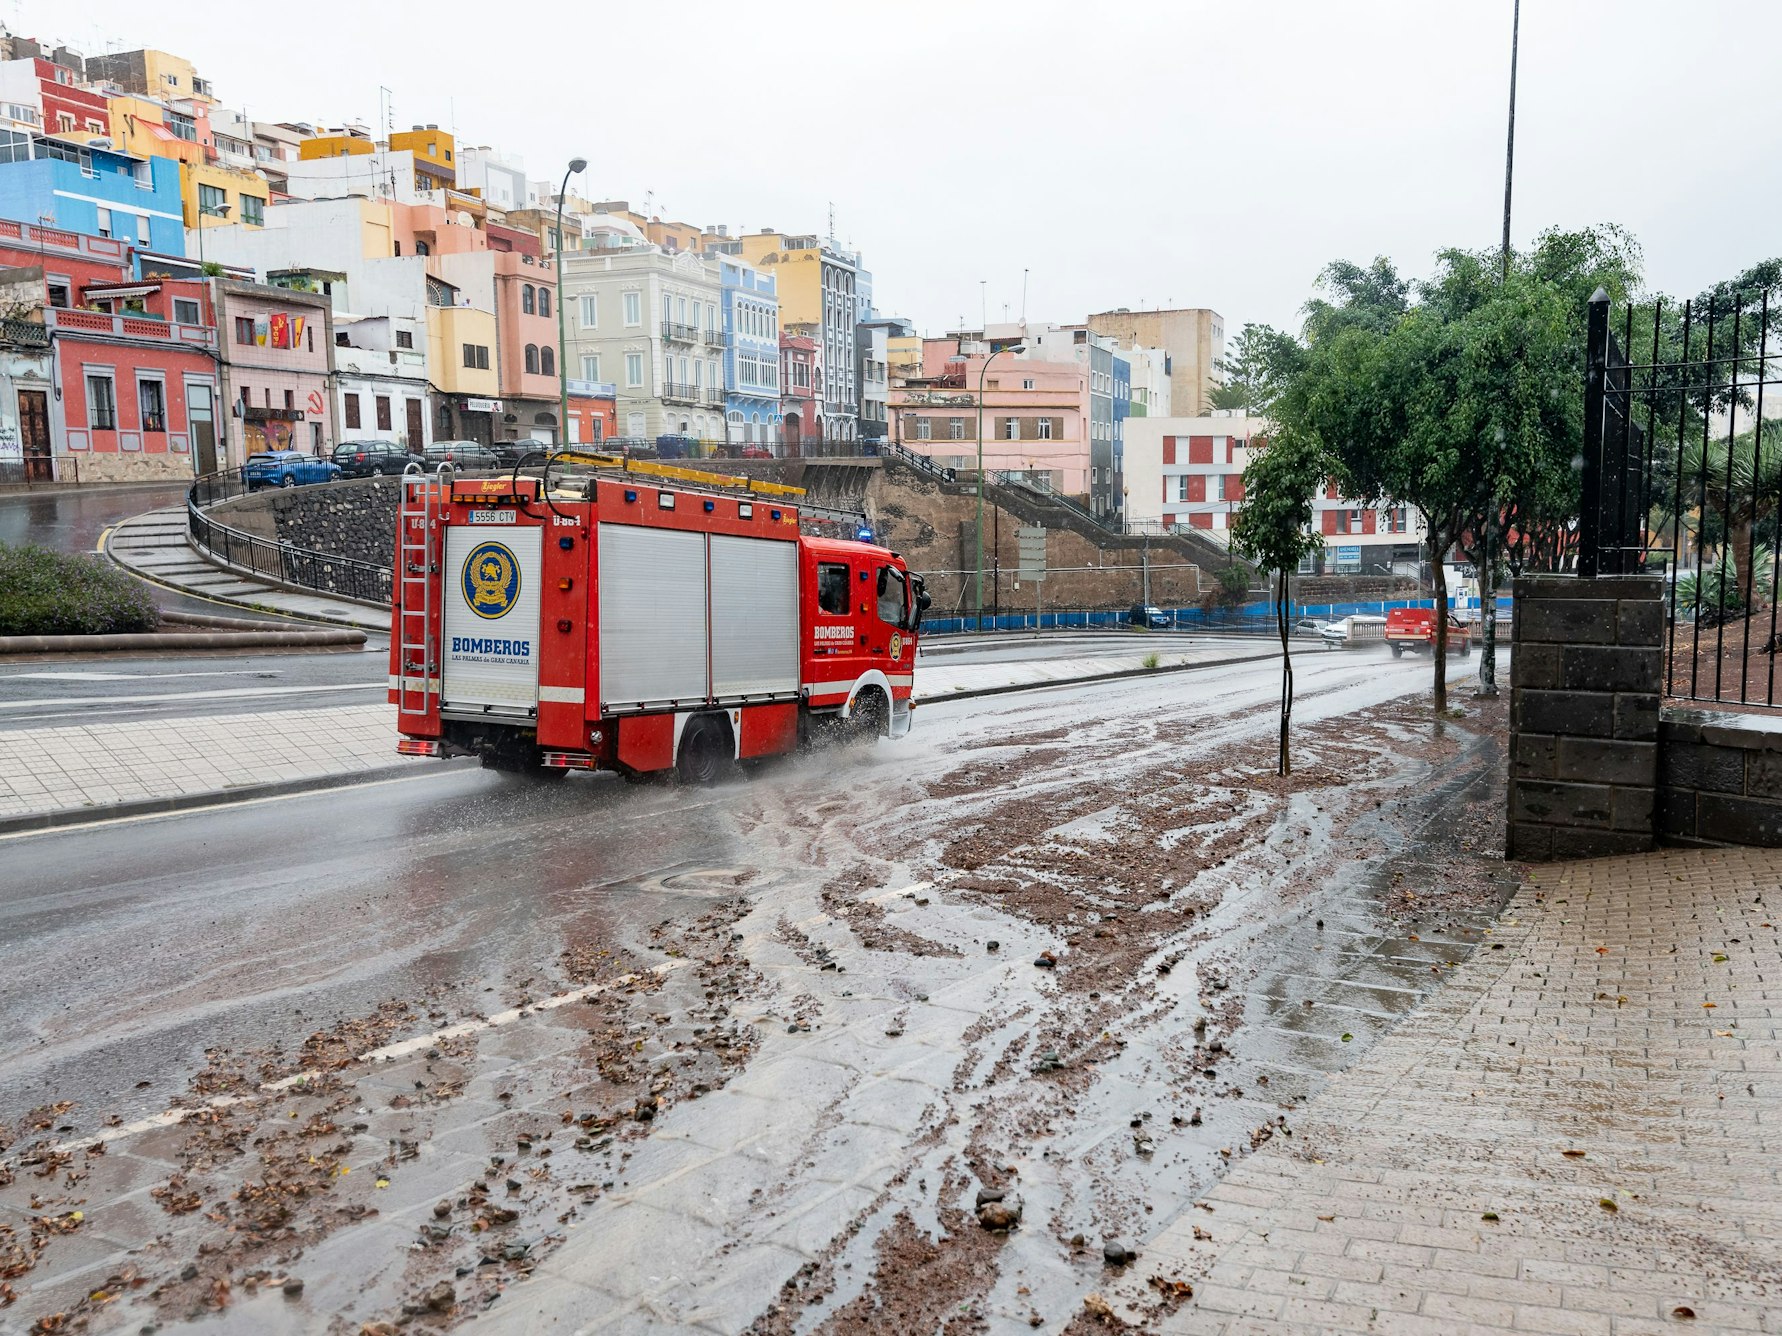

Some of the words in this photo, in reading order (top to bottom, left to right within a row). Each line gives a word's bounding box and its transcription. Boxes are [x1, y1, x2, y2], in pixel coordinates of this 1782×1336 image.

[481, 481, 507, 492] Ziegler
[475, 510, 496, 522] 5556
[499, 510, 516, 522] CTV
[411, 518, 437, 529] U-84
[814, 626, 855, 639] BOMBEROS
[452, 637, 530, 656] BOMBEROS
[462, 655, 482, 663] PALMAS
